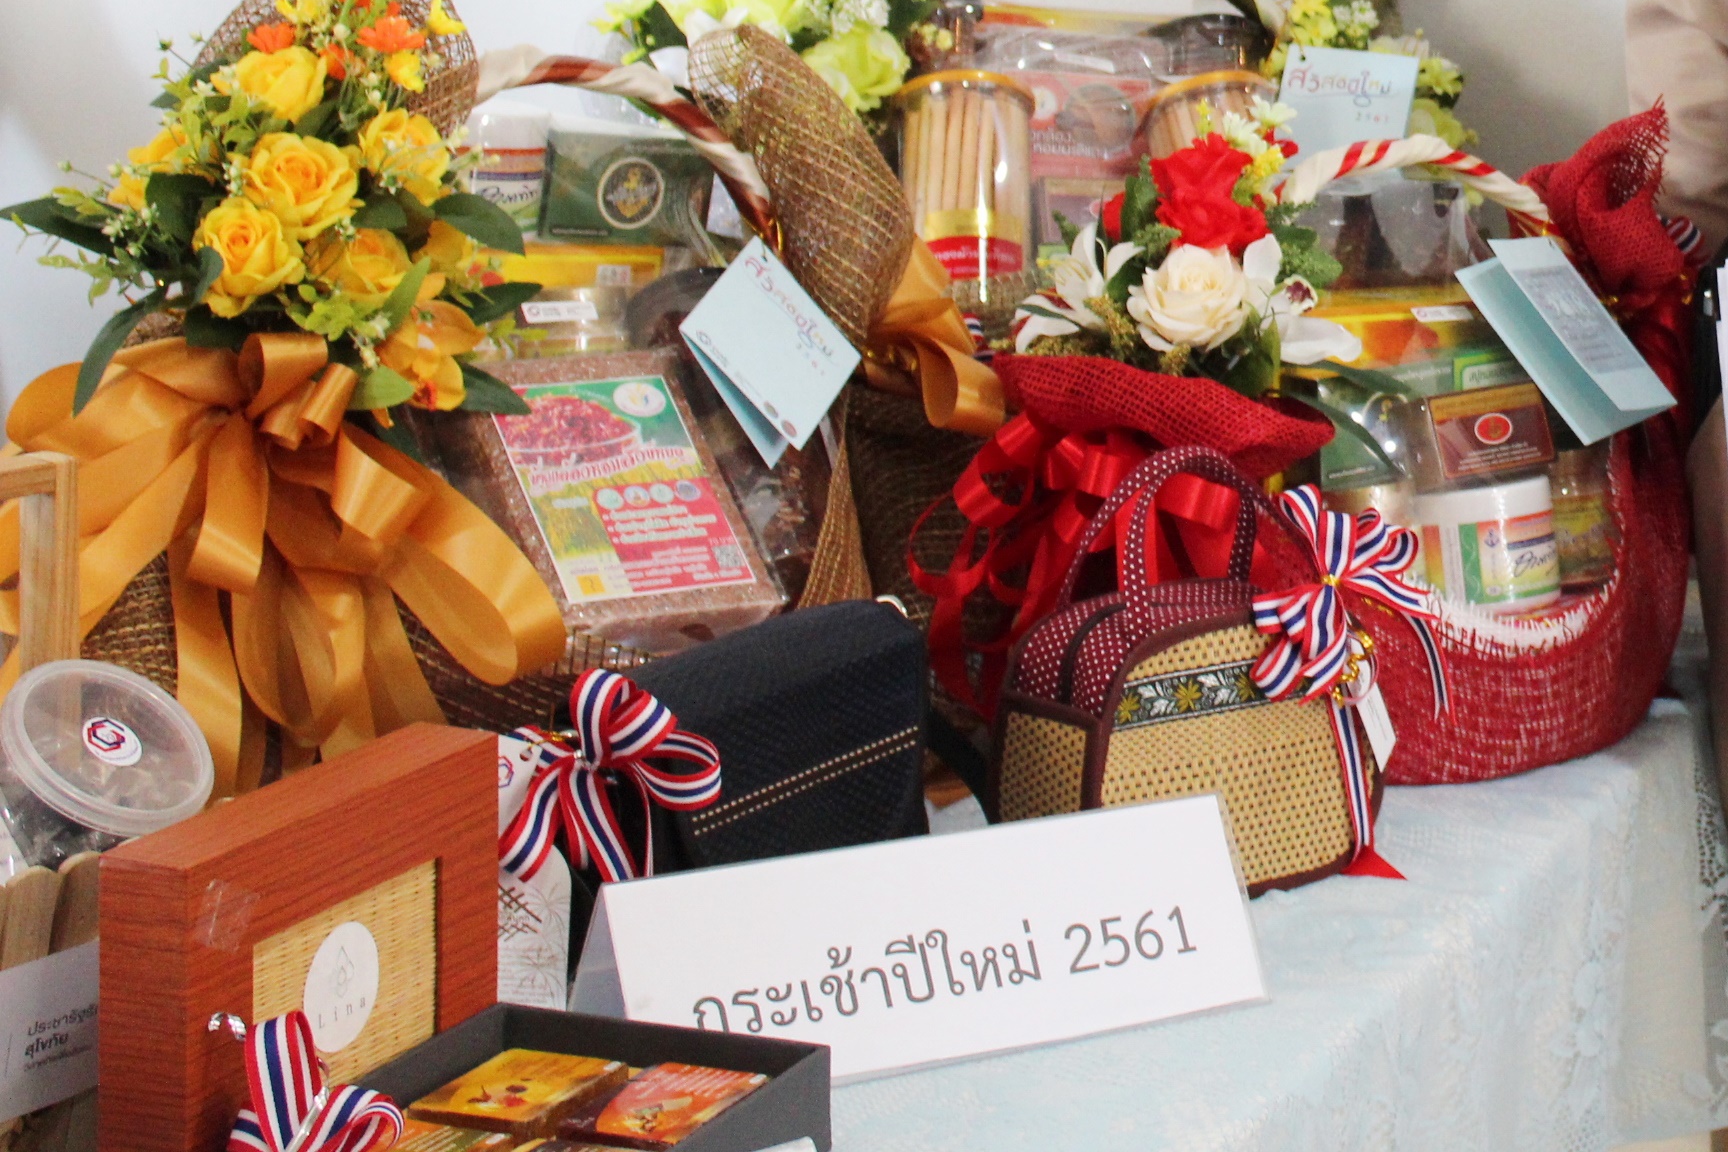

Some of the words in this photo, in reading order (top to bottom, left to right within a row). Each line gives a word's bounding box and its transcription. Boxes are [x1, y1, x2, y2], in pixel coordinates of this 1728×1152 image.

[692, 918, 1043, 1033] กระเช้าปีใหม่
[1063, 903, 1199, 976] 2561
